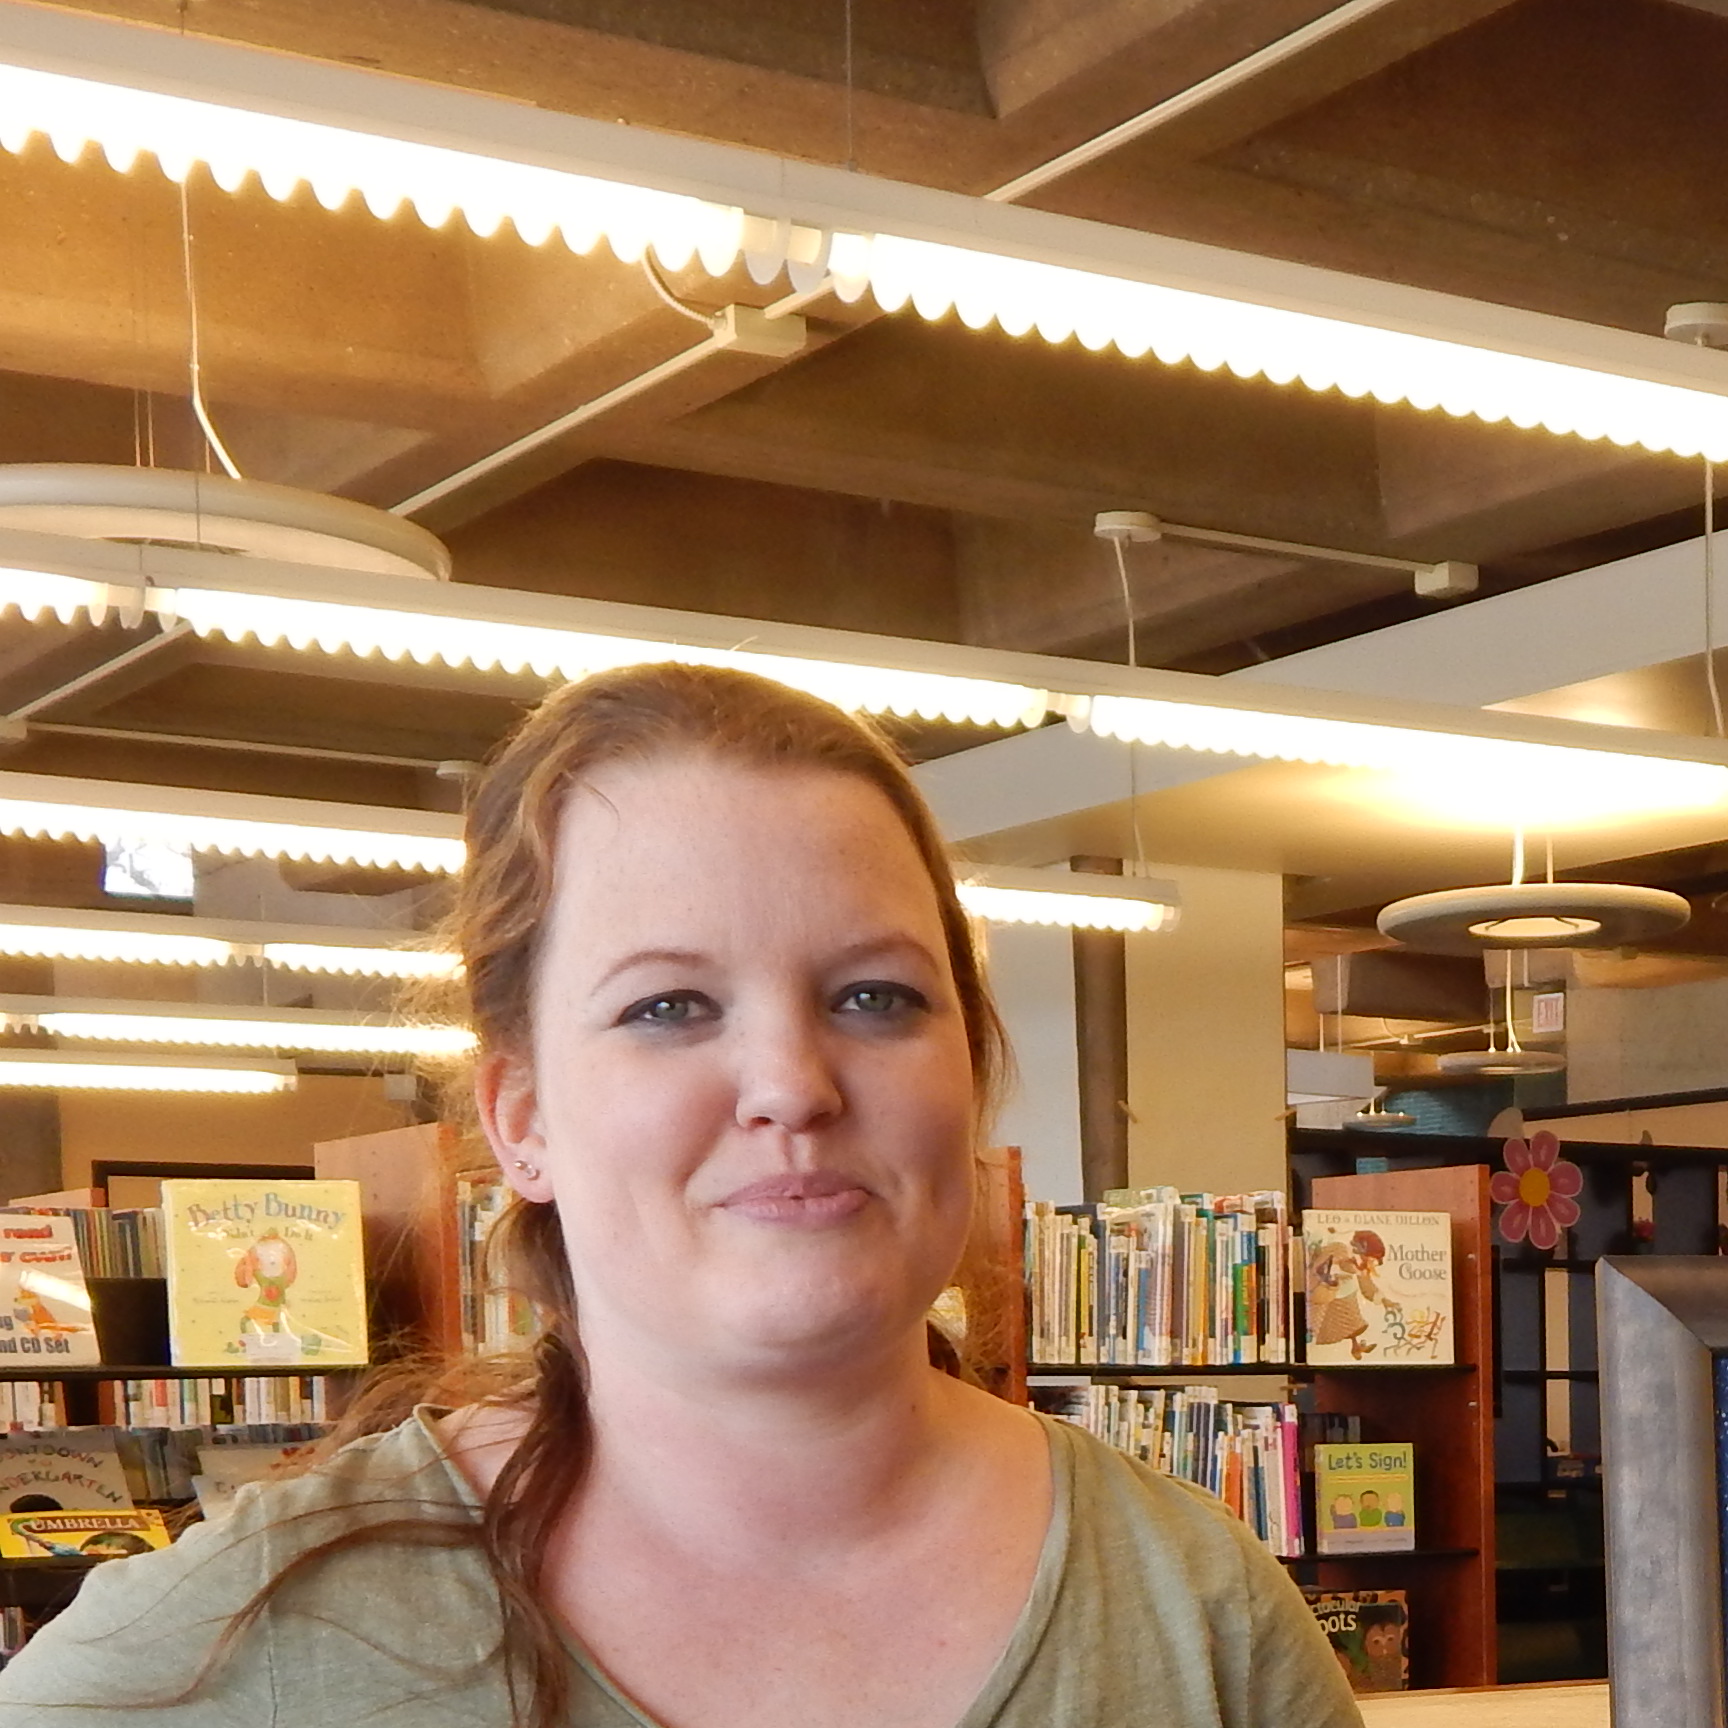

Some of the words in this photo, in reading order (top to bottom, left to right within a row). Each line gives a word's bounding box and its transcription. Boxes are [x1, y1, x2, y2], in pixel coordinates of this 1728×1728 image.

[187, 1194, 258, 1227] Betty
[264, 1192, 347, 1229] Bunny
[1387, 1243, 1447, 1261] Mother
[1398, 1263, 1447, 1280] Goose
[0, 1337, 17, 1353] nd
[20, 1337, 41, 1353] CD
[44, 1337, 70, 1353] Set
[1328, 1452, 1363, 1470] Let's
[1369, 1450, 1407, 1471] Sign!
[30, 1517, 141, 1531] UMBRELLA
